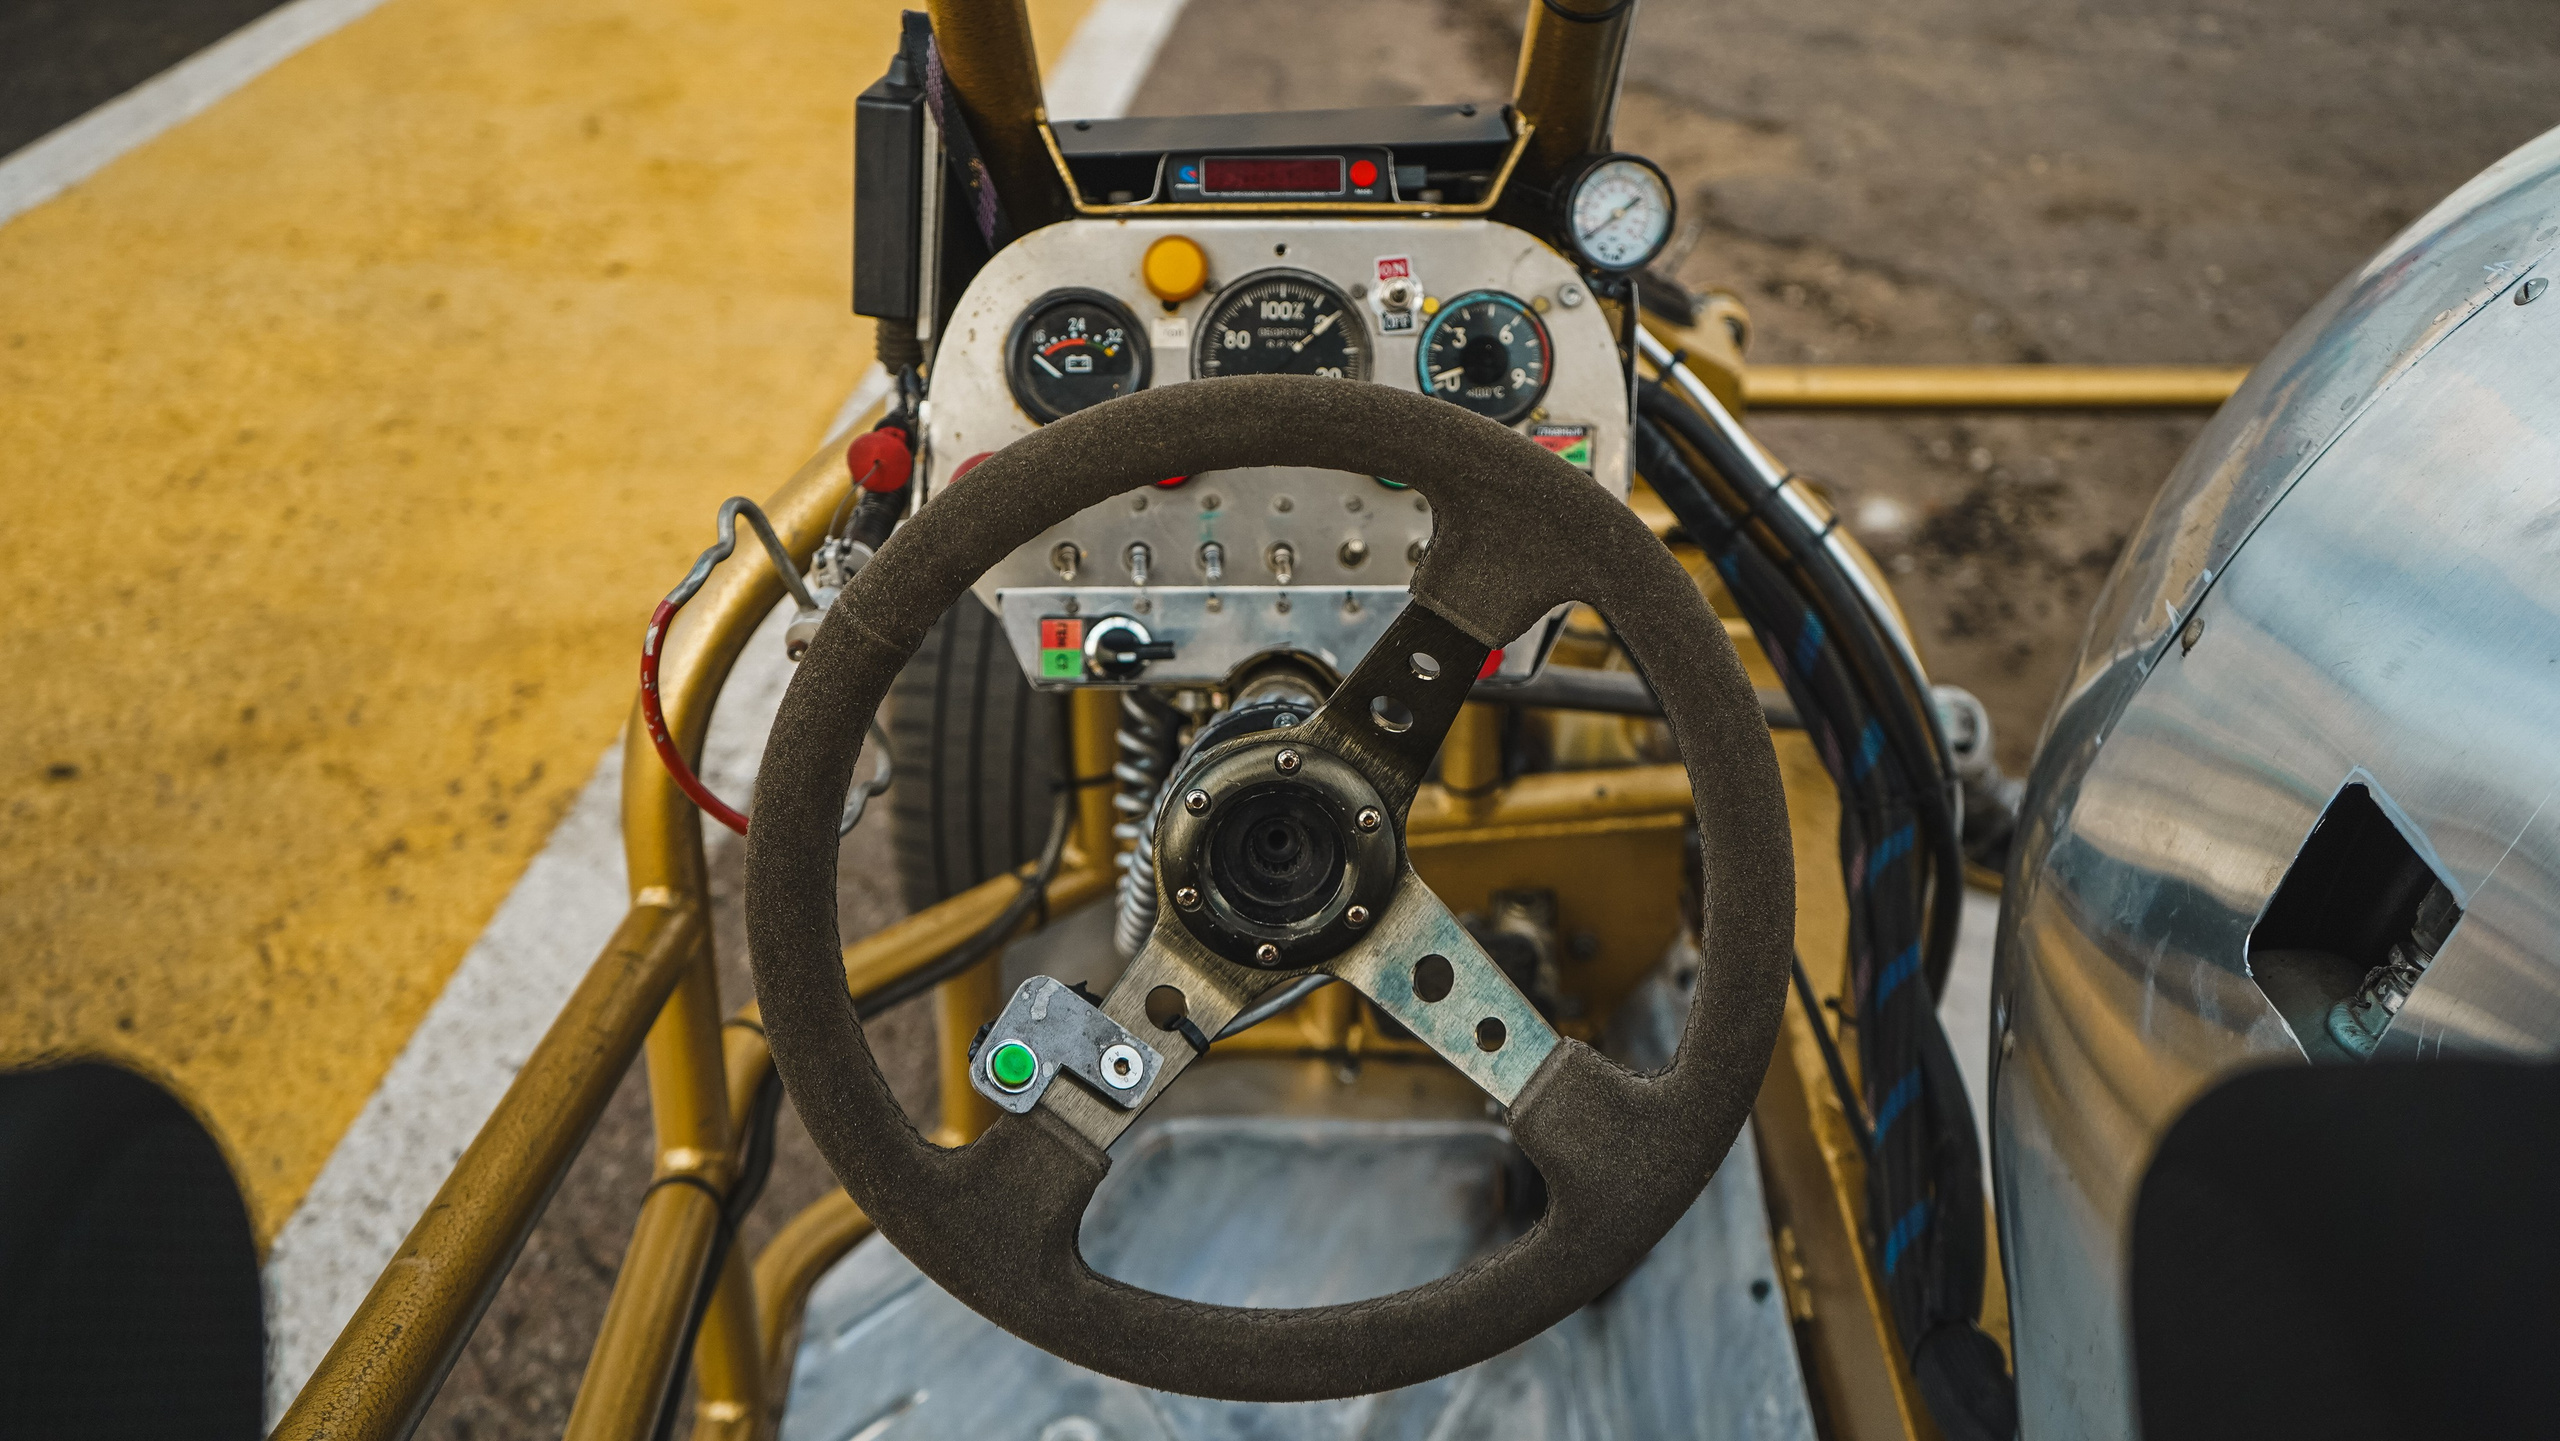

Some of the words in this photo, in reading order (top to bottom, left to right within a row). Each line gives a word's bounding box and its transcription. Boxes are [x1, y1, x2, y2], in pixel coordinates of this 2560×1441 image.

[1380, 261, 1407, 276] ON
[1261, 301, 1306, 320] 100%
[1067, 317, 1086, 332] 24
[1106, 328, 1124, 343] 32
[1224, 330, 1251, 350] 80
[1452, 327, 1467, 349] 3
[1499, 324, 1514, 345] 6
[1511, 368, 1526, 390] 9
